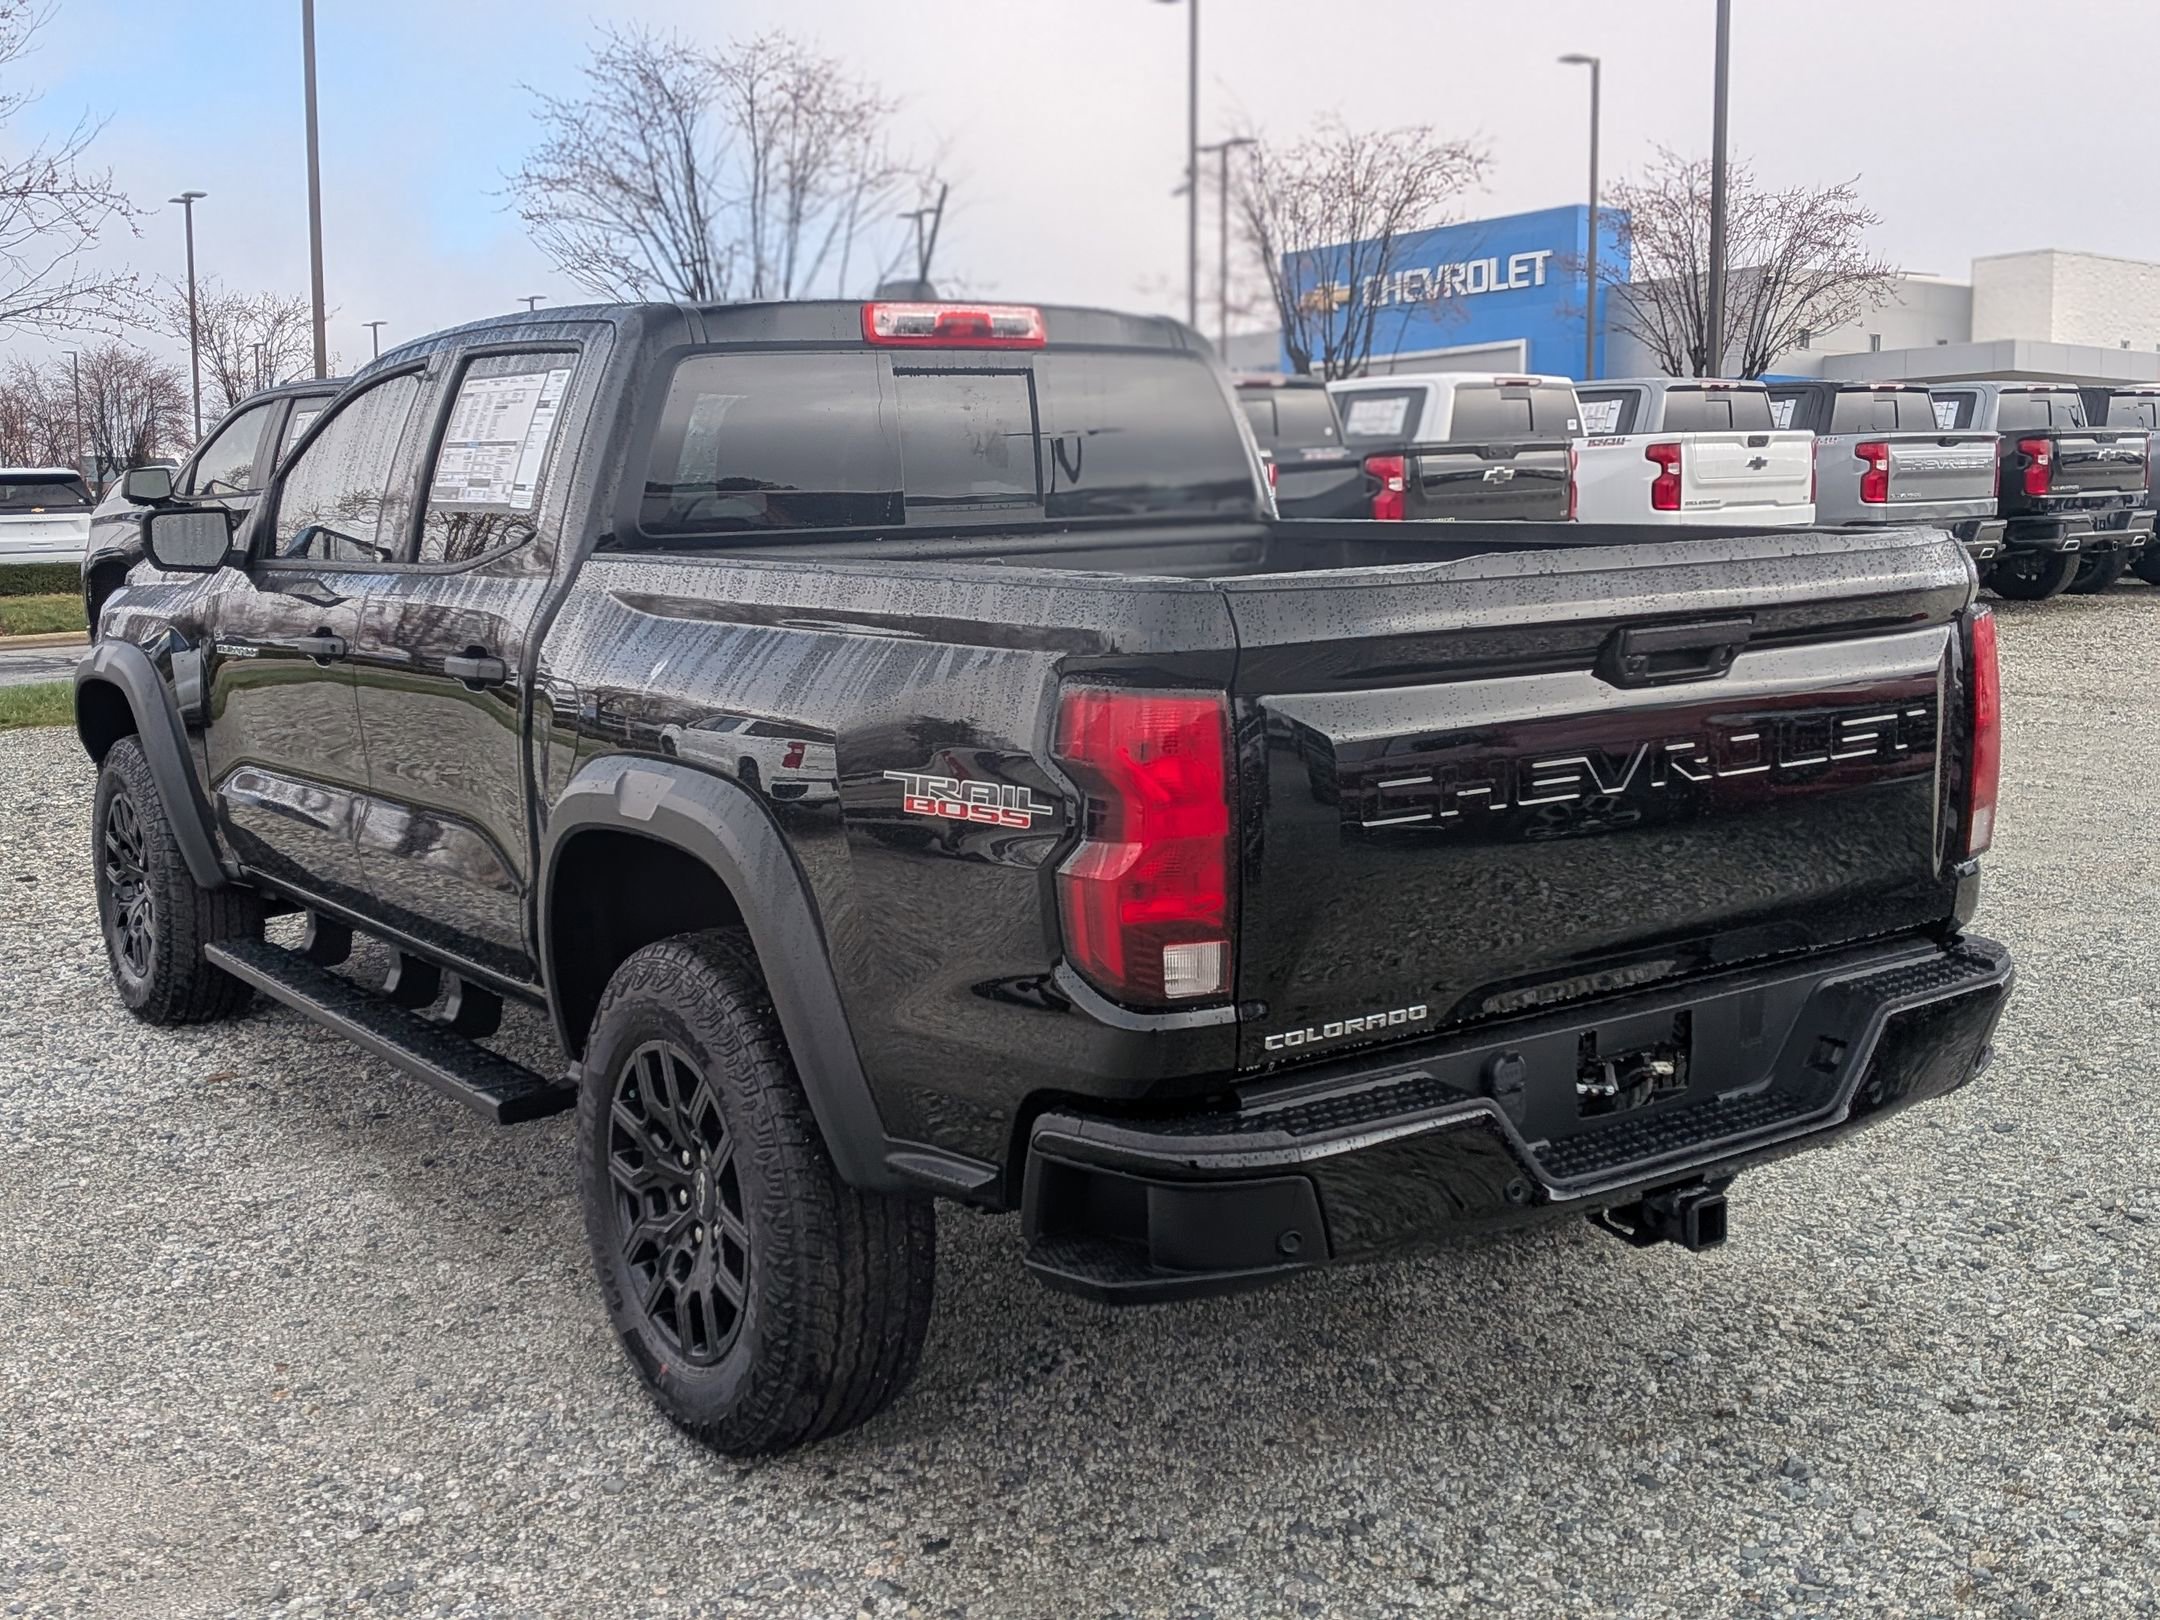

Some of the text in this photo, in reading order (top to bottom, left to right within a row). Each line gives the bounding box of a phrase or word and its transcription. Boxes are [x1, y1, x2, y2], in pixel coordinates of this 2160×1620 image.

[1362, 249, 1553, 307] CHEVROLET
[1361, 702, 1927, 827] CHEVROLET
[883, 770, 1053, 815] TRAIL
[904, 794, 1032, 829] BOSS
[1265, 1004, 1428, 1051] COLORADO
